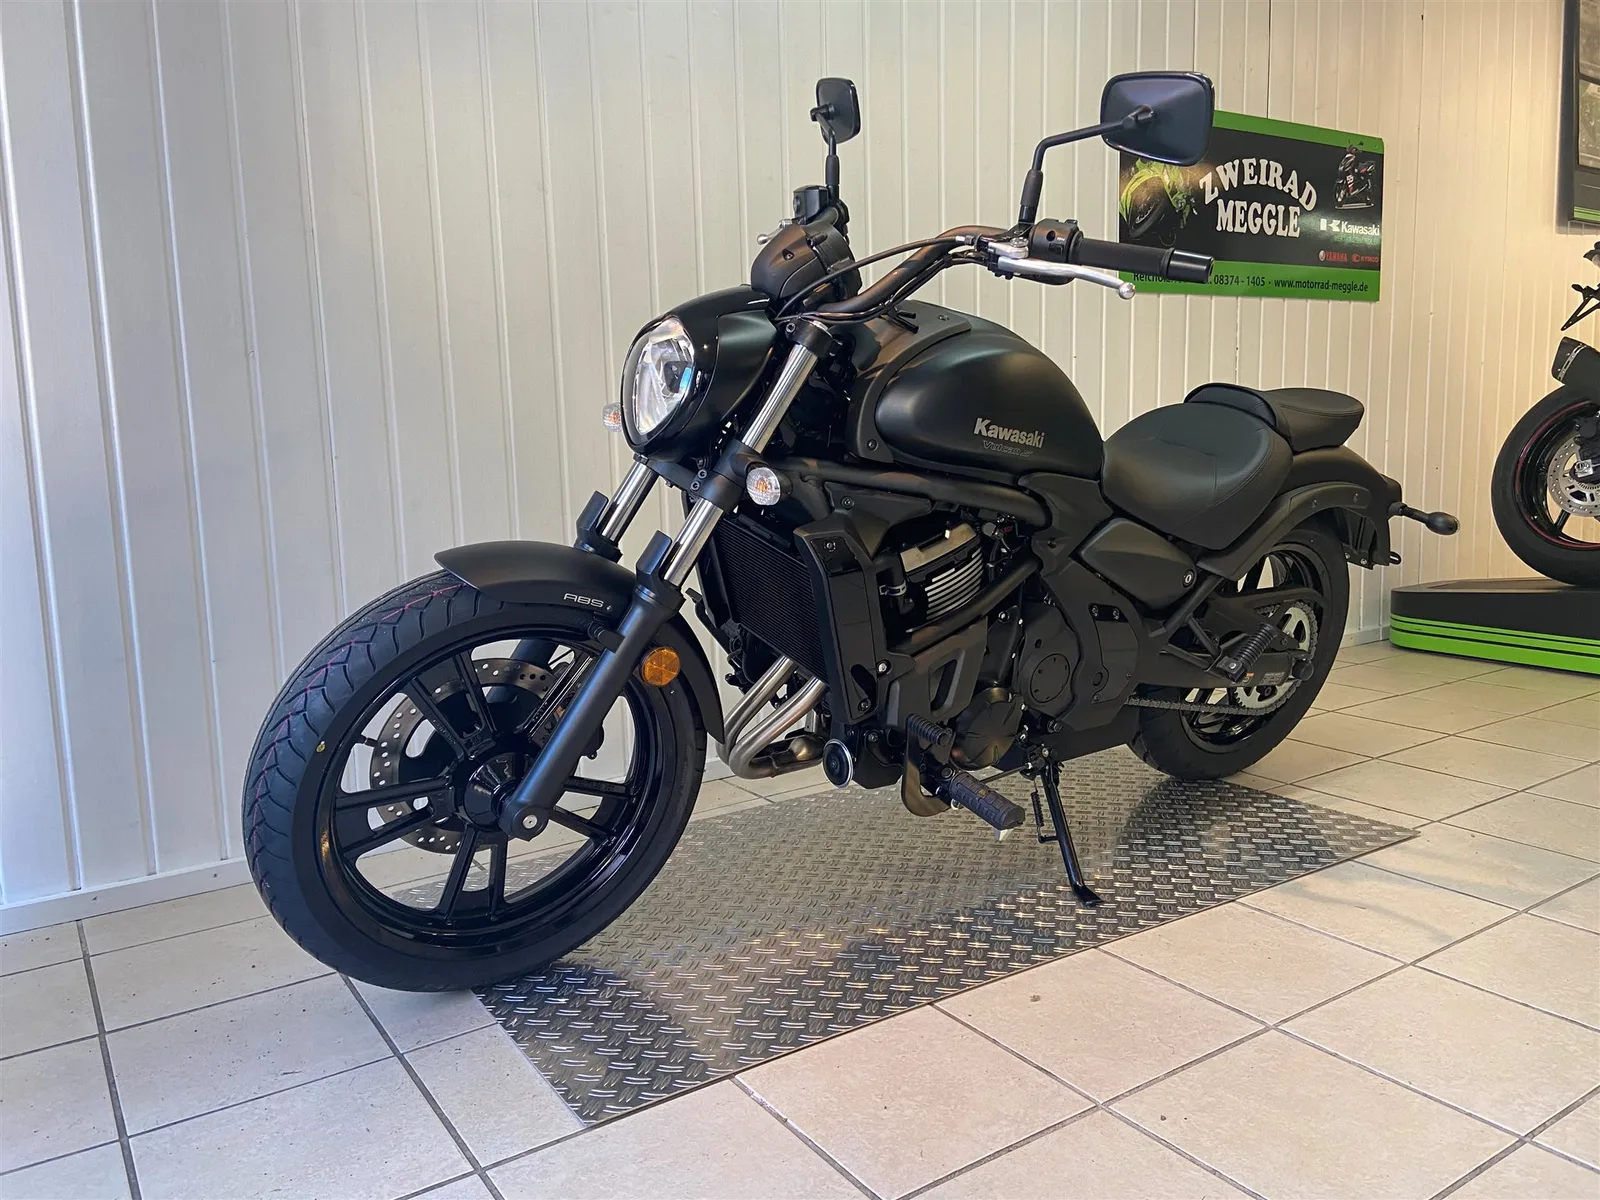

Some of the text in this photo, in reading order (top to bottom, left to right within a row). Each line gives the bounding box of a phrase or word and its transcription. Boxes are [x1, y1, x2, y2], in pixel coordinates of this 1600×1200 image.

[1199, 158, 1317, 211] ZWEIRAD
[1216, 199, 1300, 238] MEGGLE
[1341, 221, 1380, 236] Kawasaki
[1325, 251, 1348, 262] YAMAHA
[1213, 274, 1240, 285] 08374
[1246, 276, 1265, 287] 1405
[1274, 279, 1369, 294] www.motorrad-meggle.de
[973, 417, 1045, 449] Kawasaki
[563, 592, 604, 608] ABS
